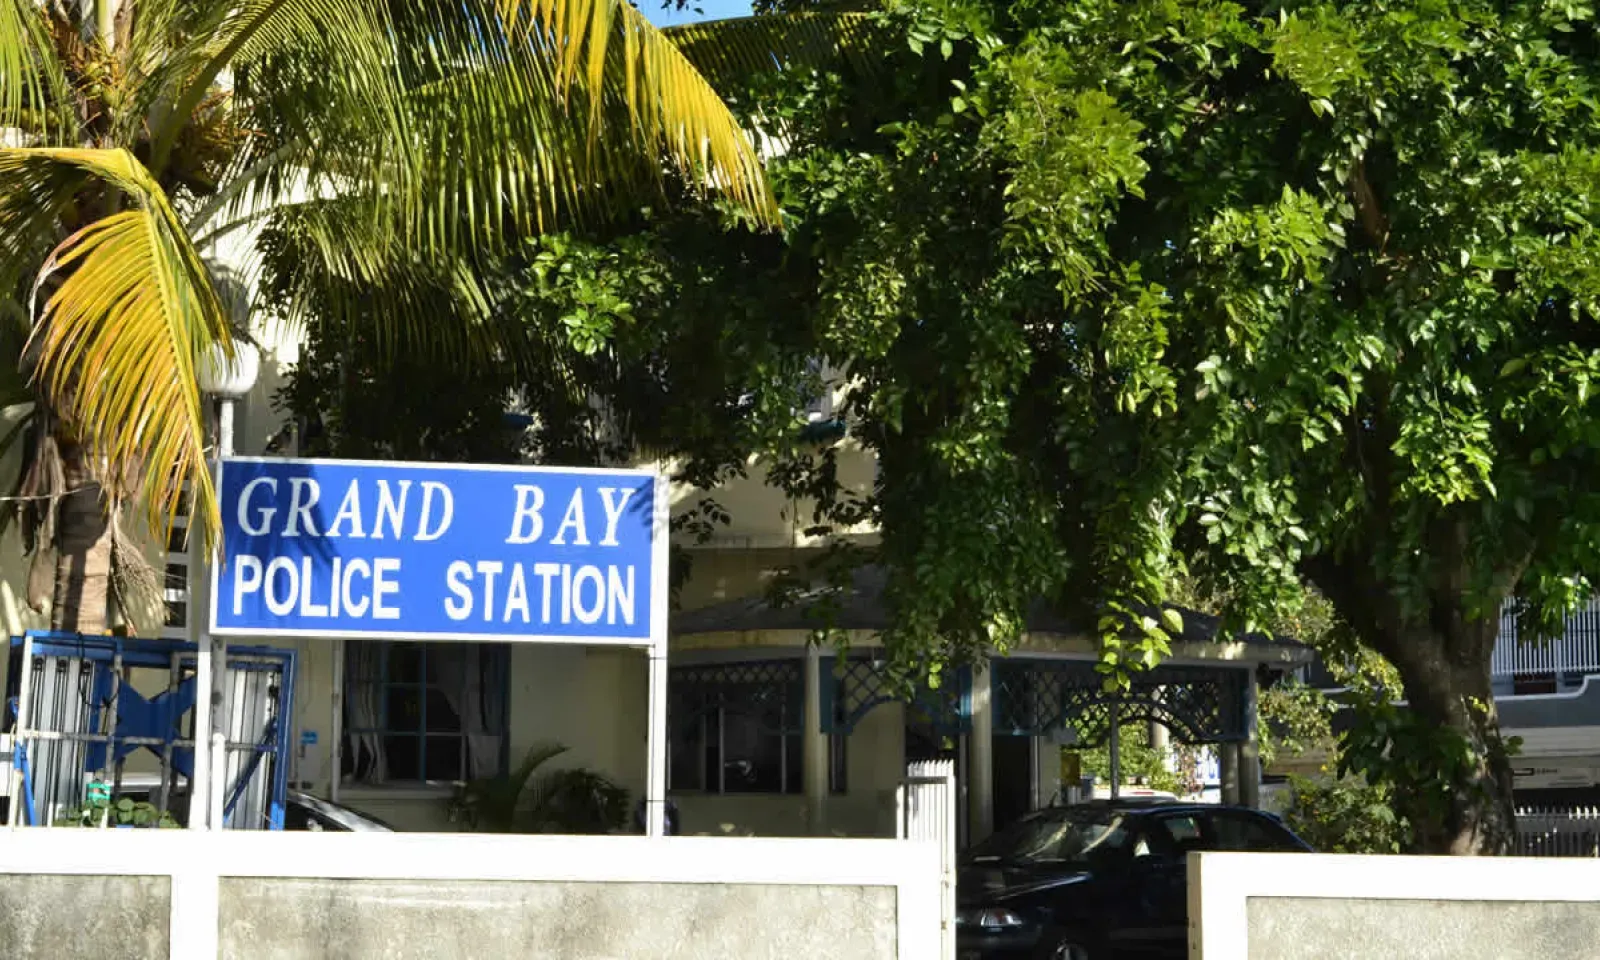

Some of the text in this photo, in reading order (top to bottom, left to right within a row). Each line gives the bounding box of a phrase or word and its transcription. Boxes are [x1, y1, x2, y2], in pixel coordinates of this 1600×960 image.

[237, 478, 635, 547] GRAND BAY
[233, 554, 635, 625] POLICE STATION
